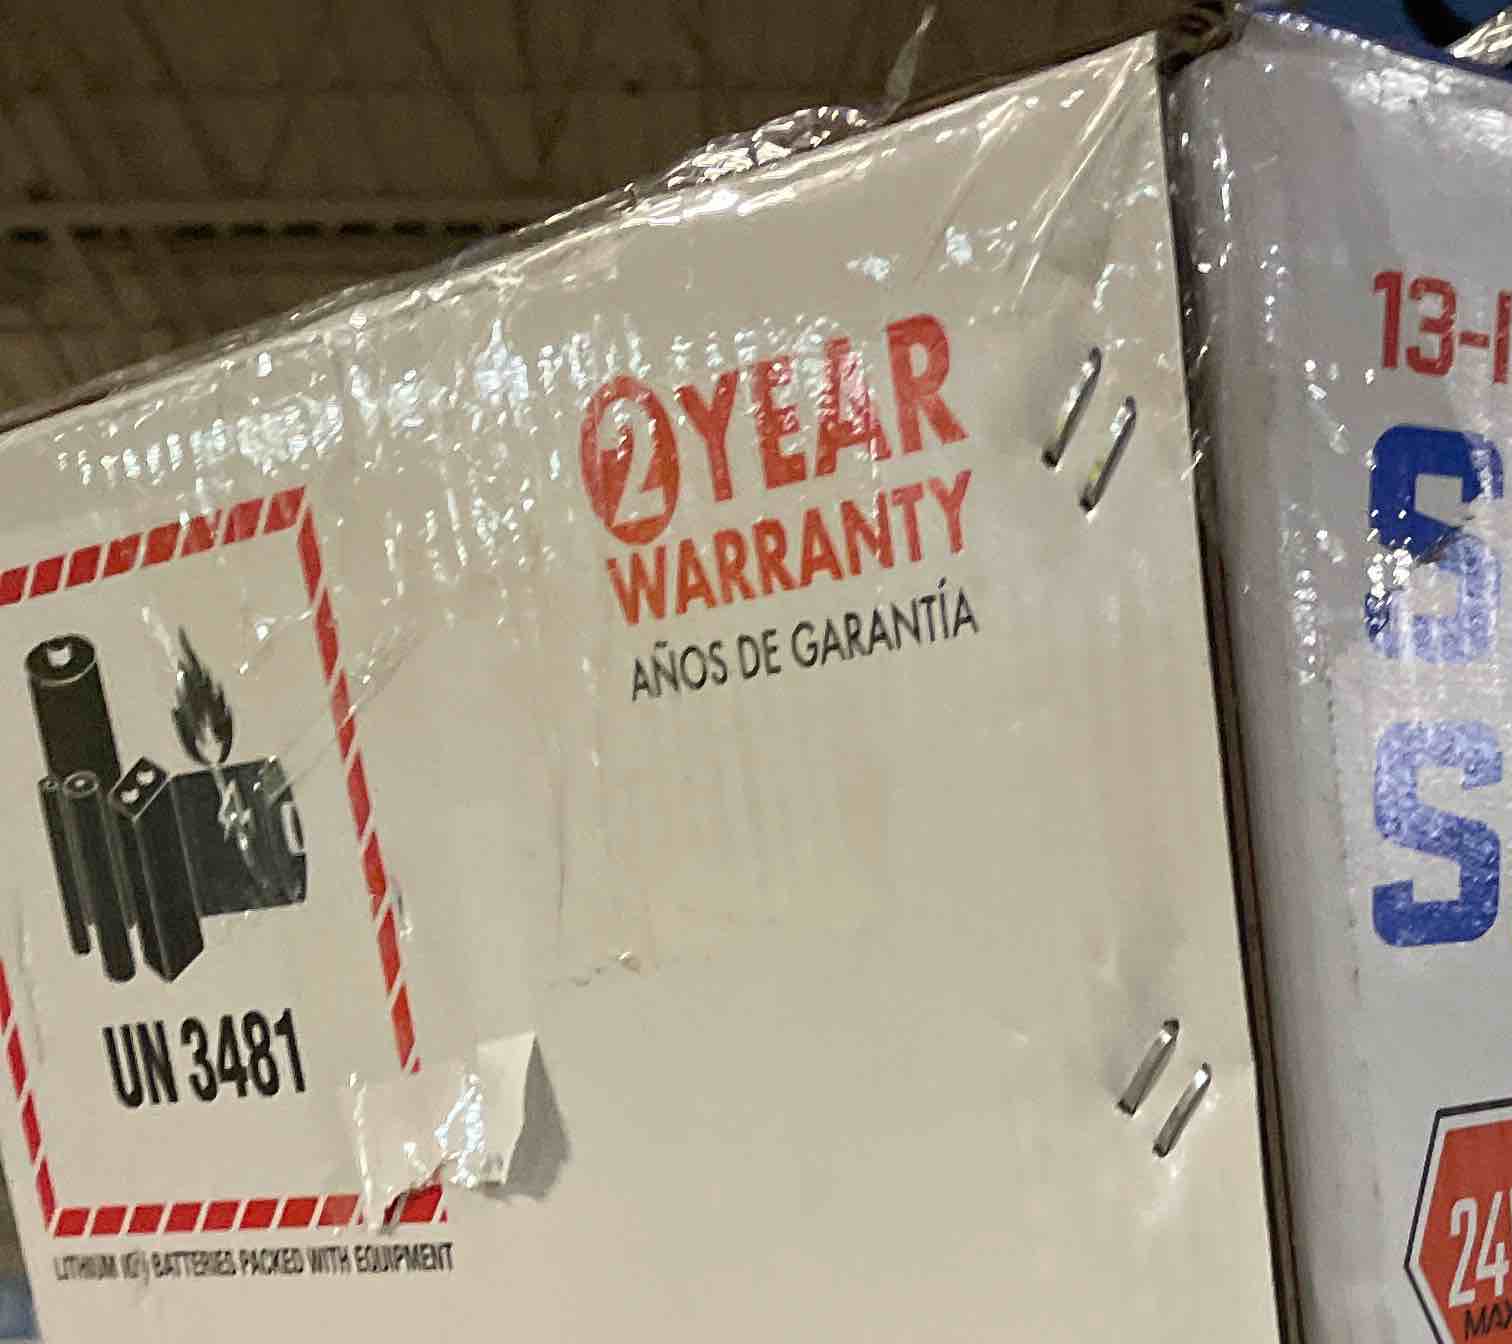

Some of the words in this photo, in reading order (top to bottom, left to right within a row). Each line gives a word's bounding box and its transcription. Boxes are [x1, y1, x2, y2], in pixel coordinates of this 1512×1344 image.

[677, 313, 969, 503] YEAR
[604, 469, 972, 626] WARRANTY
[632, 638, 728, 701] AÑOS
[737, 628, 782, 680] DE
[791, 576, 980, 667] GARANTÍA
[102, 1020, 179, 1108] UN
[186, 1007, 307, 1100] 3481
[150, 1247, 237, 1279] BATTERIES
[237, 1246, 305, 1277] PACKED
[305, 1244, 352, 1275] WITH
[353, 1241, 455, 1275] EQUIPMENT
